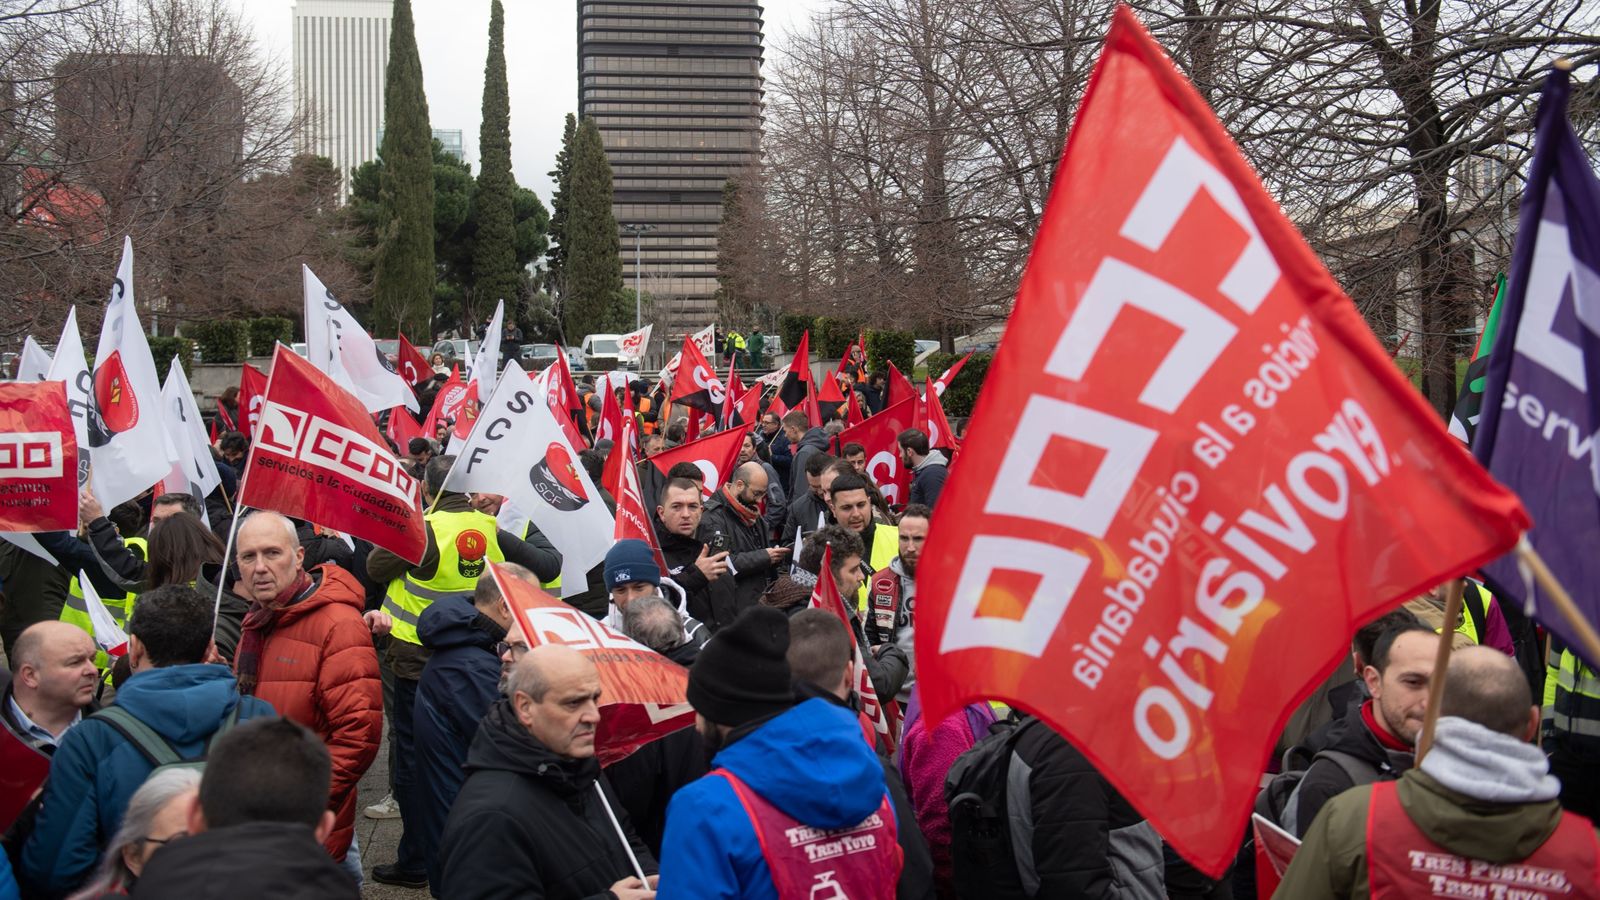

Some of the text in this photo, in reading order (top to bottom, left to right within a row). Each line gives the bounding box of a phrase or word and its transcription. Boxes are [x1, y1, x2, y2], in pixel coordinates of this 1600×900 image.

[257, 455, 314, 482] servicios
[316, 474, 324, 483] a
[310, 428, 413, 497] CCOO
[534, 482, 562, 504] SCF
[463, 569, 479, 577] SCF
